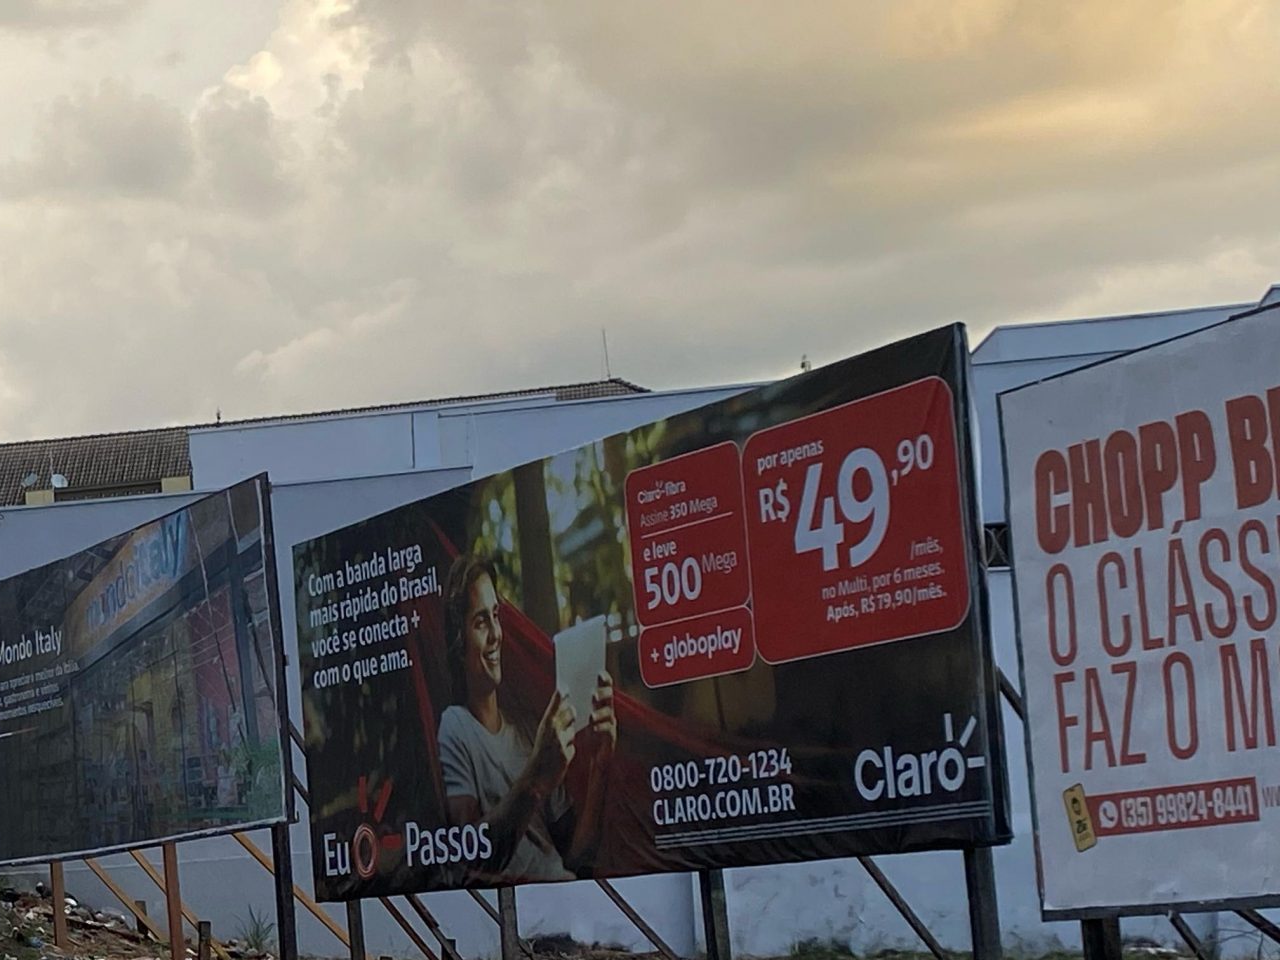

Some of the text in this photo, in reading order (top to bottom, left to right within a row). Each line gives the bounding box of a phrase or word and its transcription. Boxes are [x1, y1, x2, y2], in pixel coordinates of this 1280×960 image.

[757, 439, 825, 476] por apenas
[1035, 385, 1280, 554] CHOPP B
[640, 495, 718, 528] Assine 350 Mega
[759, 478, 791, 523] R$
[308, 544, 423, 597] Com a banda larga
[643, 541, 677, 562] e leve
[310, 566, 442, 628] mais rápida do Brasil,
[644, 551, 738, 610] 500 Mega
[822, 585, 838, 600] no
[872, 572, 893, 593] por
[893, 567, 902, 583] 6
[904, 562, 945, 580] meses.
[1046, 515, 1280, 666] O CLÁSS
[35, 625, 62, 656] Italy
[311, 628, 340, 658] você
[343, 630, 357, 651] se
[359, 614, 409, 646] conecta
[663, 626, 743, 668] globoplay
[313, 649, 413, 689] com o que ama.
[1054, 638, 1280, 773] FAZ O M
[650, 747, 793, 793] 0800-720-1234
[652, 783, 796, 826] CLARO.COM.BR
[323, 833, 352, 877] Eu
[405, 821, 493, 868] Passos
